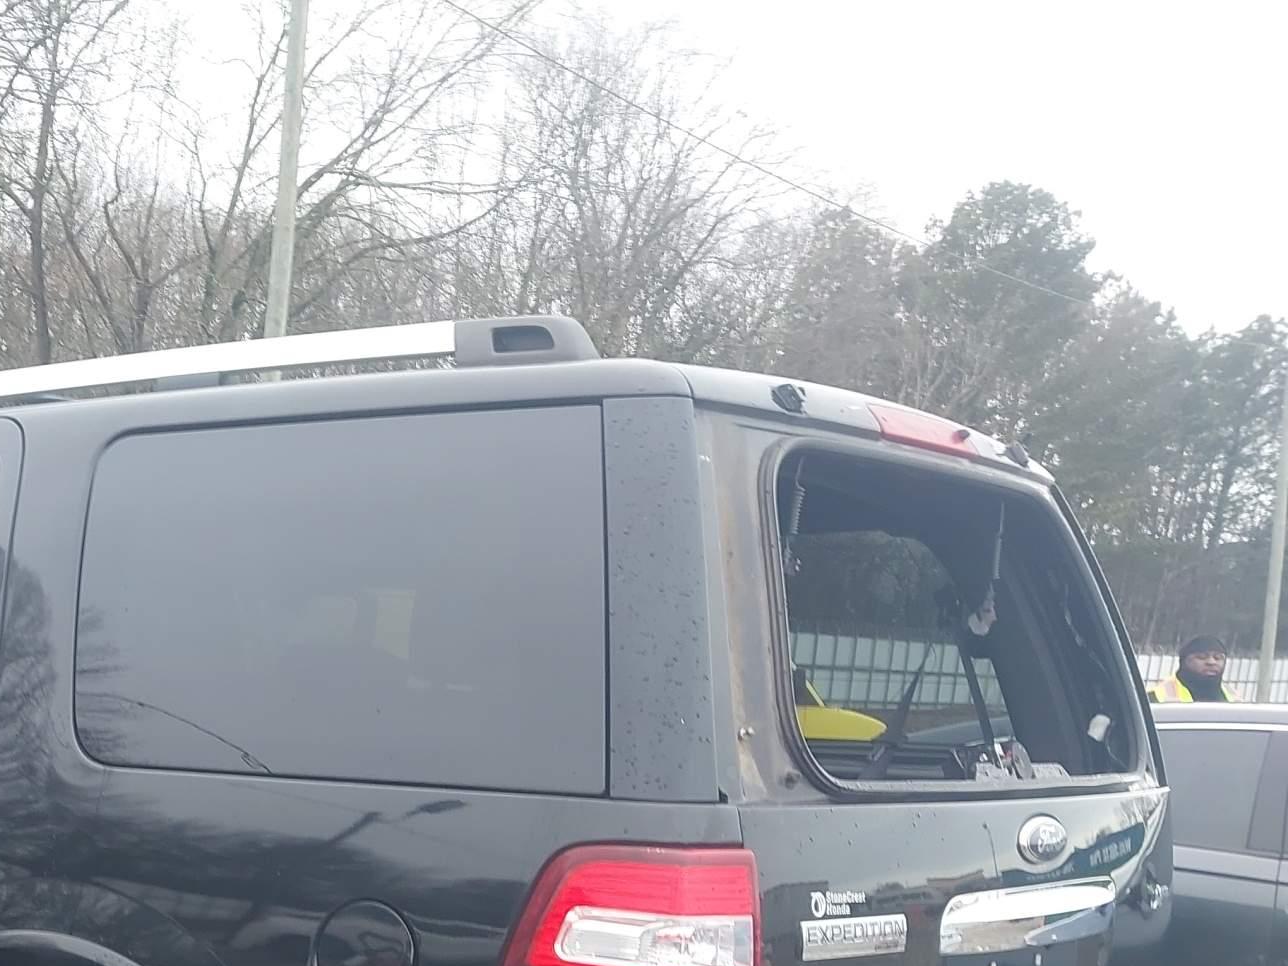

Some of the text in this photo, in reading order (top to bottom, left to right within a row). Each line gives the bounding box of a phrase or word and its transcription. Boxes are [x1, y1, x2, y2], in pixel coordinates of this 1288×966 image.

[1036, 824, 1067, 853] Ford
[825, 890, 866, 904] StoneCrest
[826, 903, 851, 915] Honda
[806, 919, 905, 945] EXPEDITION
